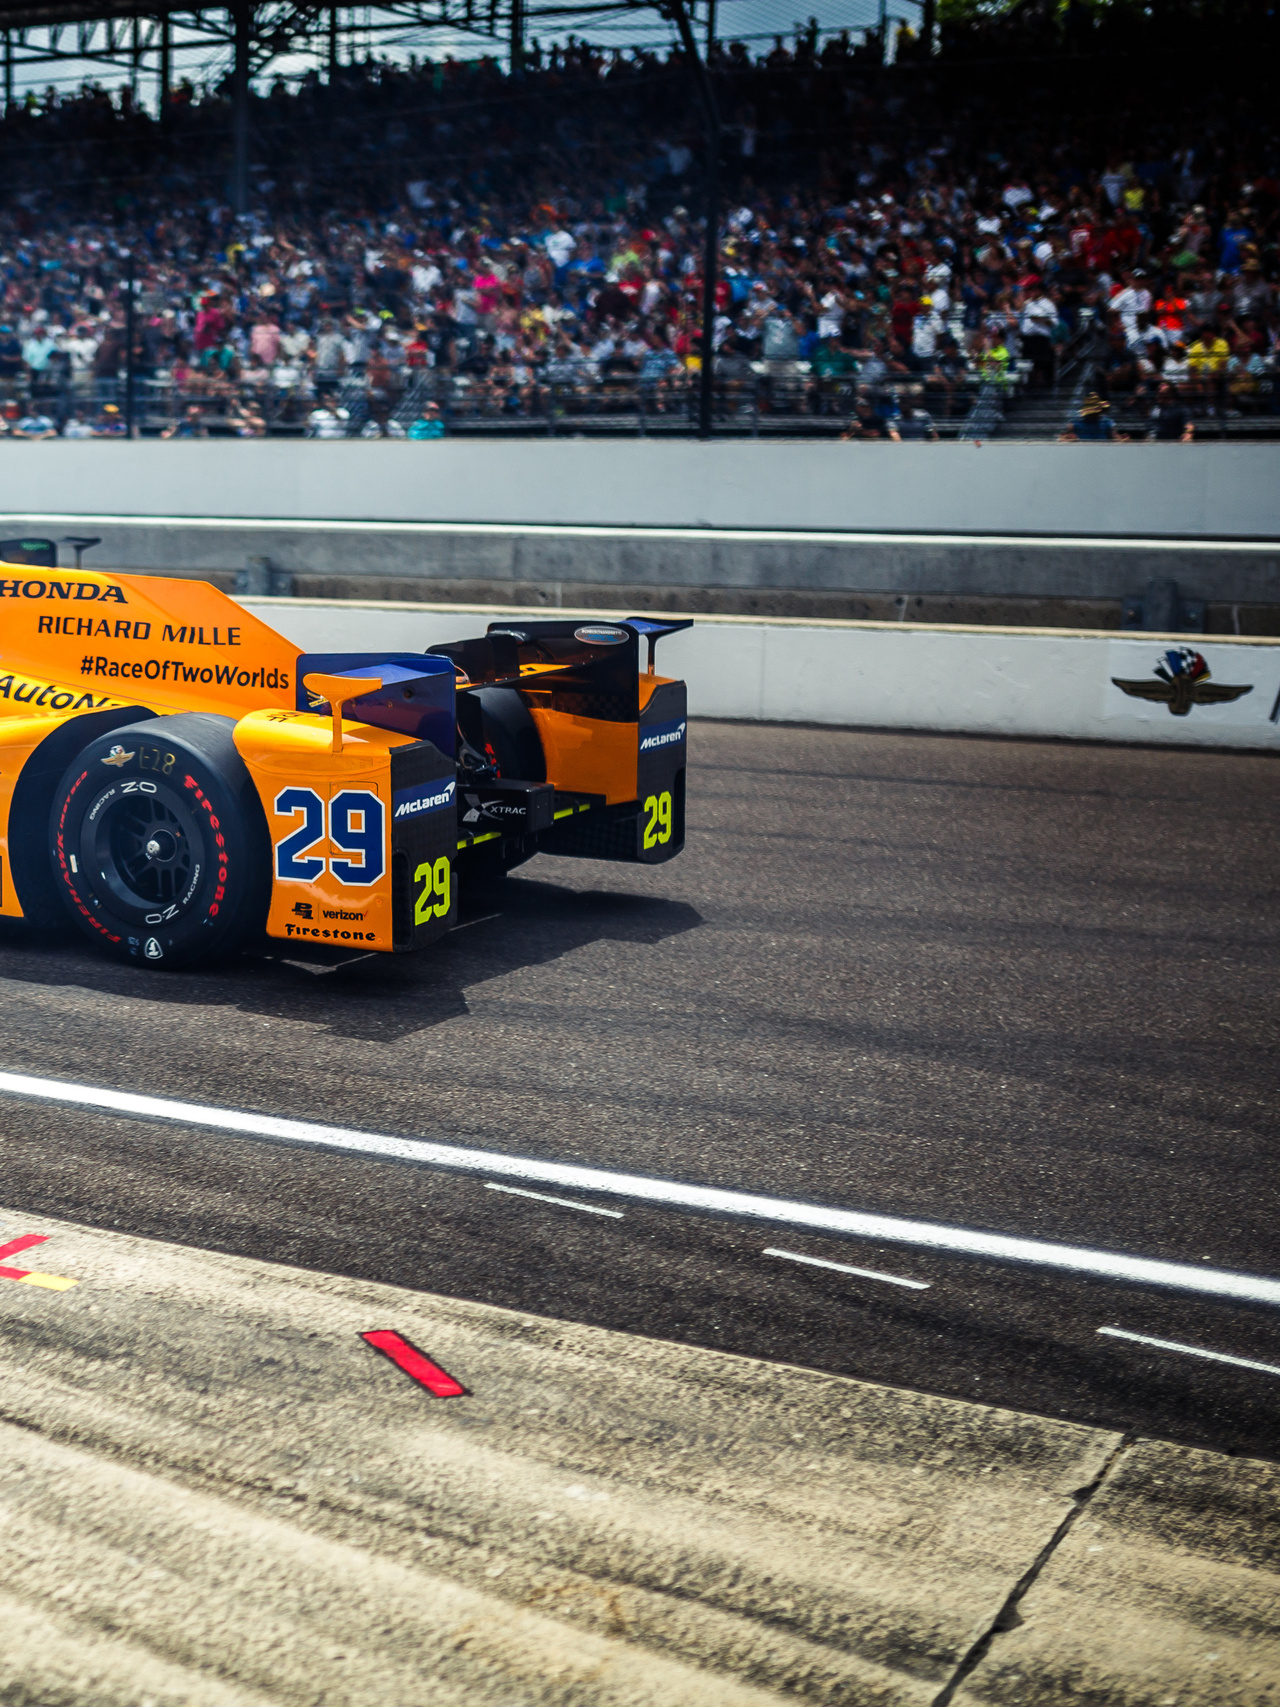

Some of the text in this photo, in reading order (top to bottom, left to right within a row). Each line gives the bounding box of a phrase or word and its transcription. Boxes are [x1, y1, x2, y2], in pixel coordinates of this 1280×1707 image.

[38, 615, 241, 646] RICHARD MILLE
[80, 655, 289, 690] #RaceOfTwoWorlds
[640, 730, 682, 750] McLaren
[90, 789, 116, 820] RACING
[394, 791, 450, 817] McLaren
[490, 805, 527, 815] XTRAC
[644, 791, 672, 850] 29
[184, 775, 228, 916] Firestone
[274, 786, 386, 886] 29
[57, 830, 121, 943] FIREHAWK
[183, 864, 200, 905] RACING
[414, 856, 451, 926] 29
[285, 923, 376, 941] Firestone
[323, 910, 364, 921] verizon
